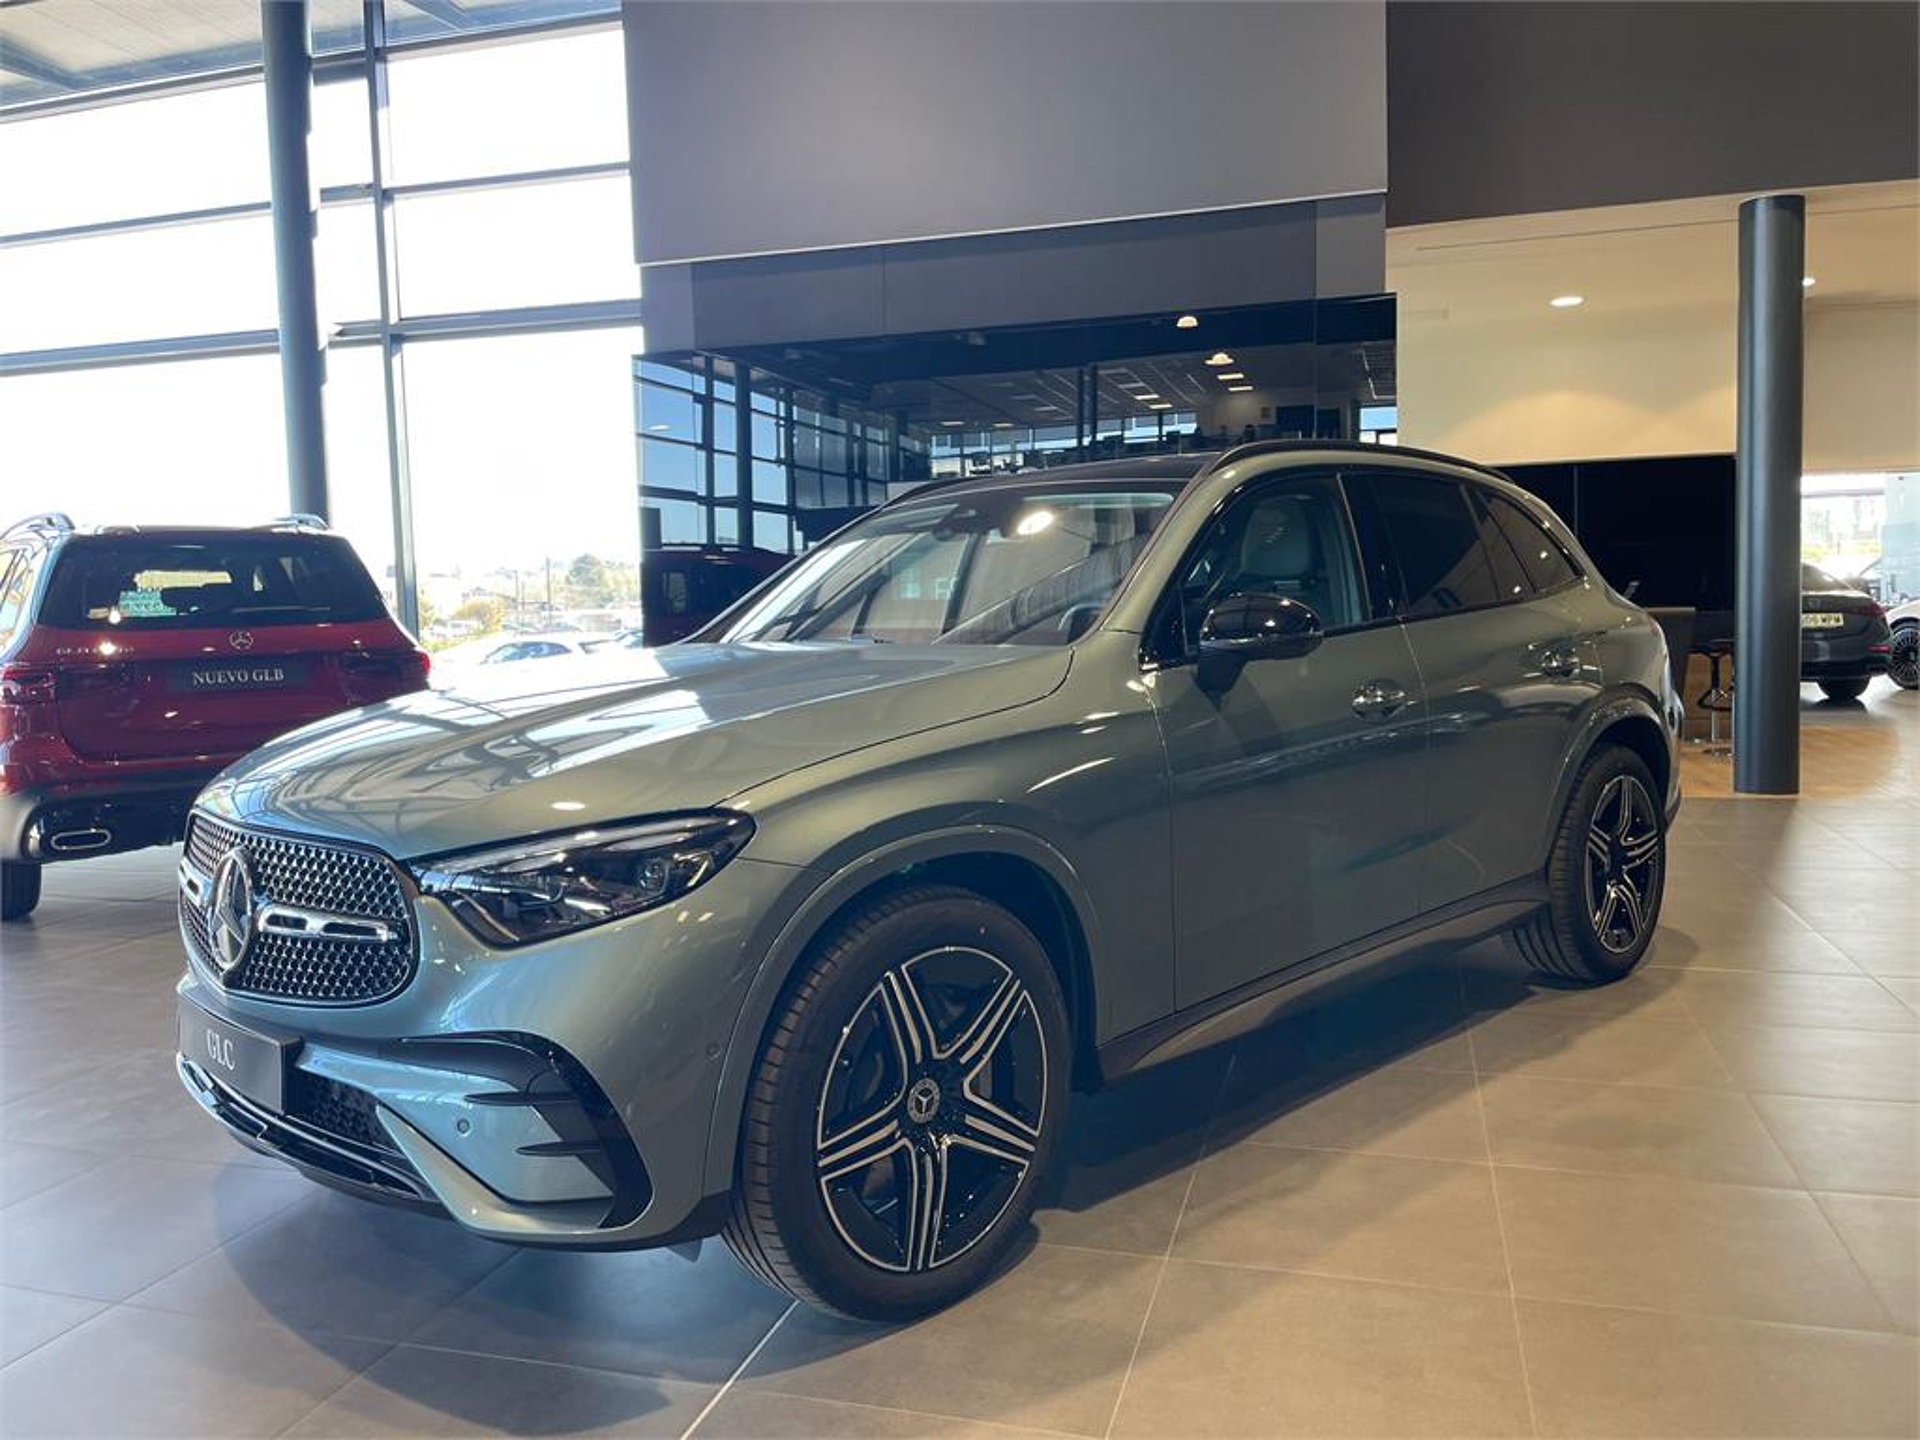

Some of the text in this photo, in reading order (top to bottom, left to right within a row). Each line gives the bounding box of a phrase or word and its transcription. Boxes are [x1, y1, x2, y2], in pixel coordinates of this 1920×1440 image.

[192, 668, 284, 685] NUEVO GLB
[206, 1029, 235, 1071] GLC
